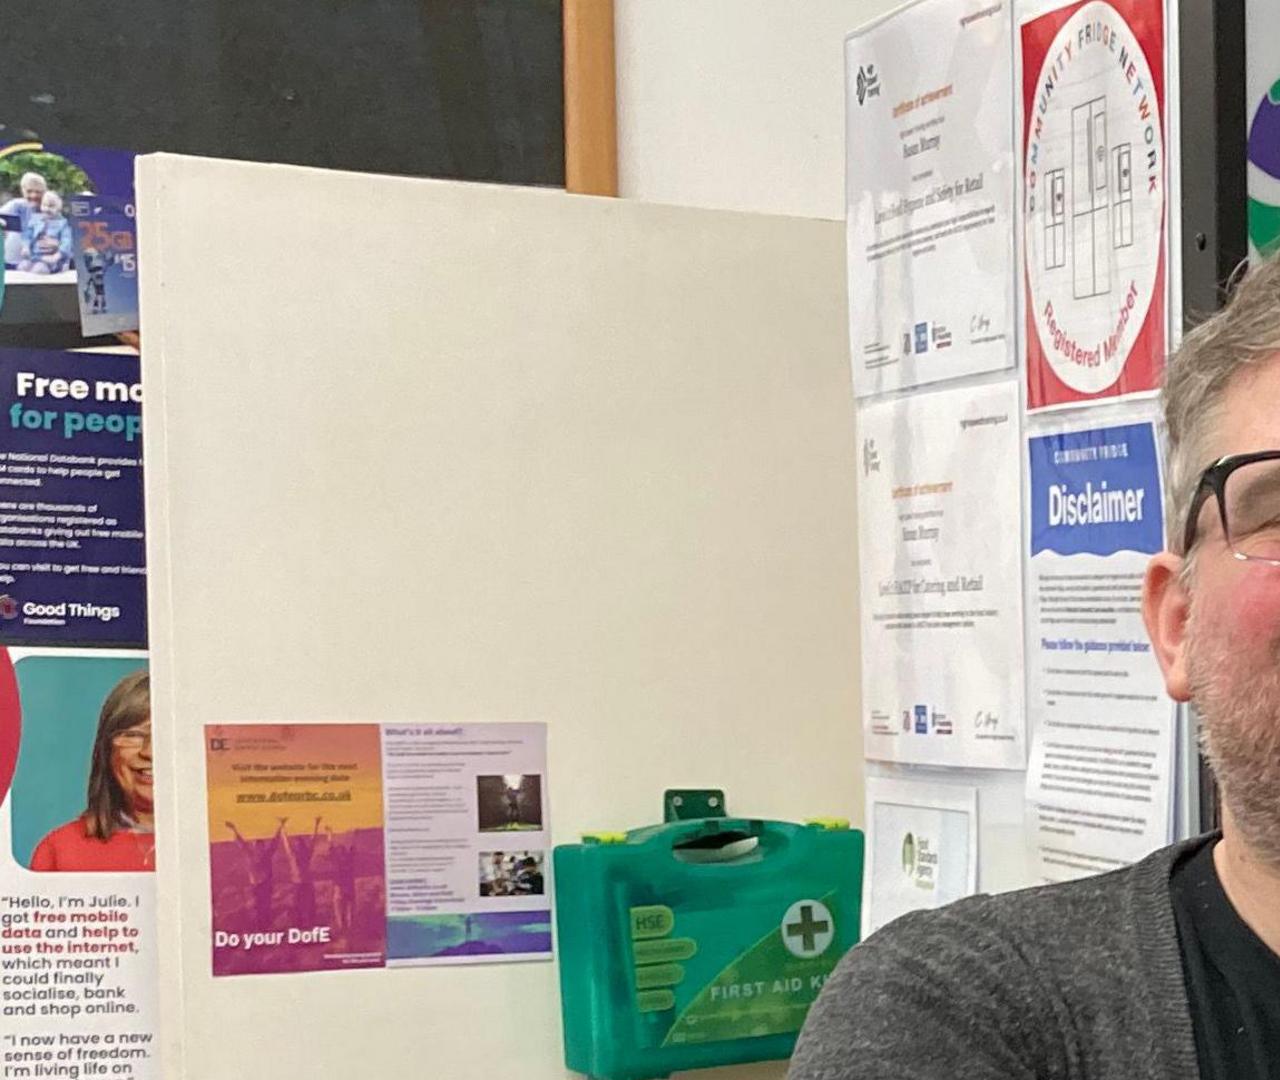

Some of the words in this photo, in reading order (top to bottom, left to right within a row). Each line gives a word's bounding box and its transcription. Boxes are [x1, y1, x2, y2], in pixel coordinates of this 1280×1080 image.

[1078, 21, 1116, 54] FRIDGE
[1119, 47, 1157, 194] NETWORK
[1044, 299, 1101, 368] Registered
[16, 372, 89, 399] Free
[9, 402, 57, 429] for
[1049, 480, 1144, 526] Disclaimer
[23, 601, 66, 617] Good
[67, 602, 120, 621] Things
[89, 895, 131, 908] Julie.
[2, 912, 28, 927] got
[33, 911, 66, 923] free
[70, 910, 128, 922] mobile
[635, 914, 665, 930] HSE
[1, 927, 41, 938] data
[45, 926, 78, 938] and
[82, 926, 118, 941] help
[122, 926, 139, 938] to
[215, 931, 240, 948] Do
[243, 930, 284, 950] your
[288, 926, 331, 944] DofE
[2, 943, 32, 954] use
[36, 942, 63, 953] the
[67, 940, 139, 954] internet,
[2, 957, 52, 969] which
[56, 957, 110, 969] meant
[2, 972, 49, 985] could
[54, 972, 104, 987] finally
[3, 988, 79, 1001] socialise,
[84, 986, 125, 999] bank
[711, 980, 764, 1000] FIRST
[772, 977, 802, 993] AID
[3, 1003, 36, 1016] and
[40, 1003, 81, 1019] shop
[85, 1001, 139, 1014] online.
[20, 1036, 55, 1046] now
[59, 1033, 100, 1045] have
[104, 1034, 115, 1043] a
[119, 1033, 153, 1043] new
[4, 1051, 53, 1062] sense
[57, 1048, 73, 1060] of
[77, 1047, 150, 1060] freedom.
[35, 1063, 80, 1079] living
[83, 1062, 108, 1075] life
[111, 1063, 132, 1074] on
